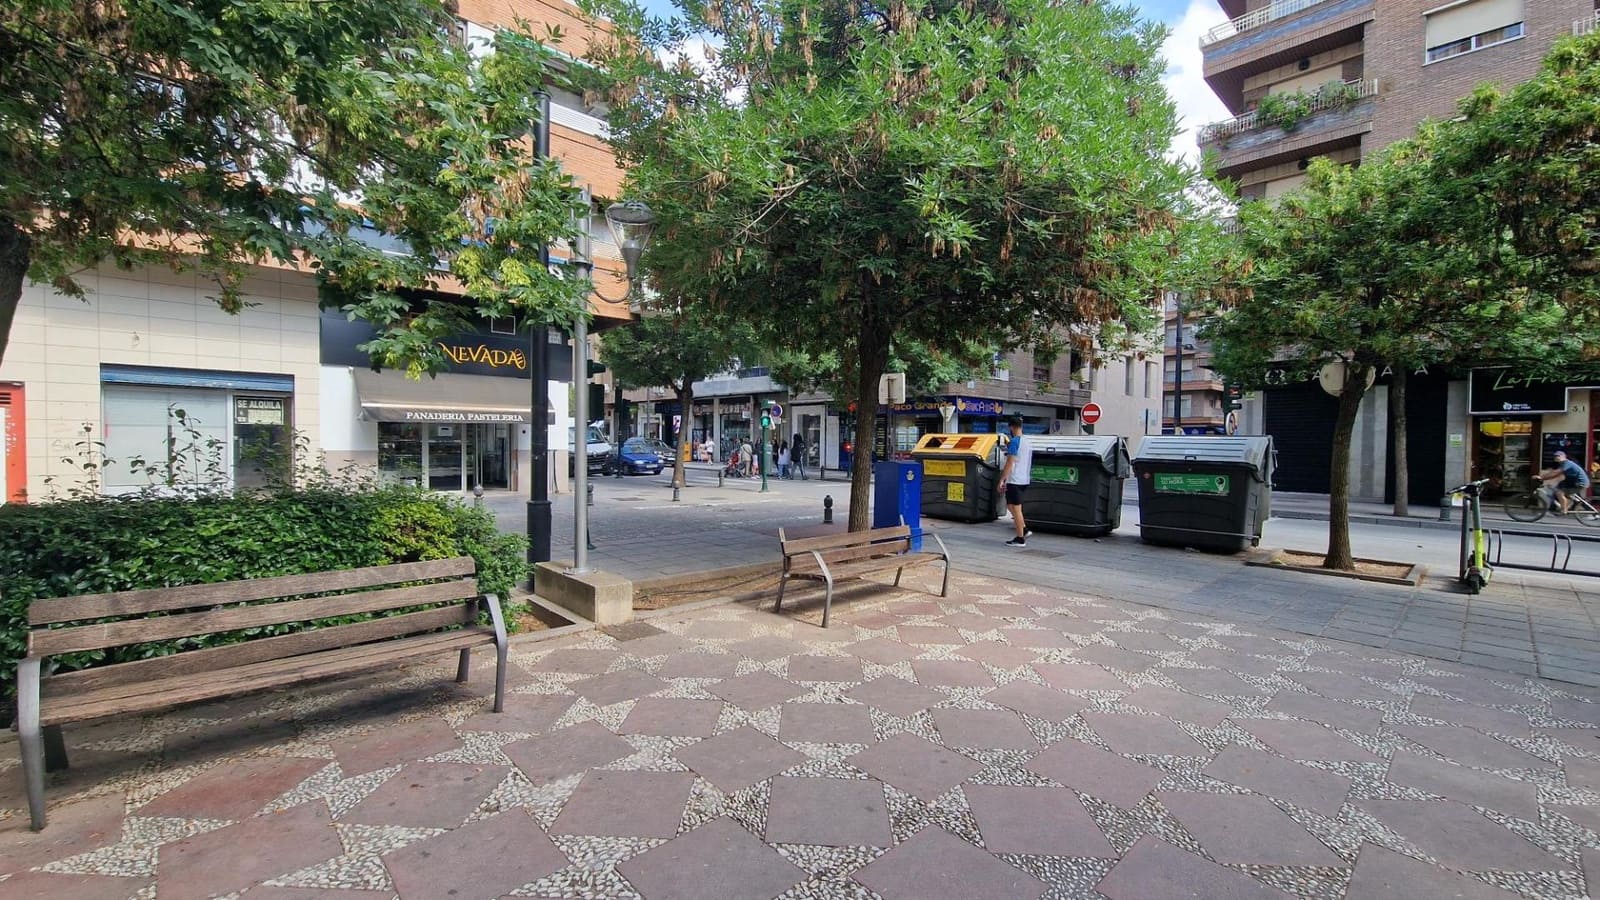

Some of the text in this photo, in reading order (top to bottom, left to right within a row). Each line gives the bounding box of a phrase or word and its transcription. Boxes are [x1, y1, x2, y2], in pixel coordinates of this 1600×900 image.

[437, 342, 524, 369] NEVADA
[237, 400, 281, 409] SE ALQUILA
[406, 411, 524, 422] PANADERIA PASTELERIA
